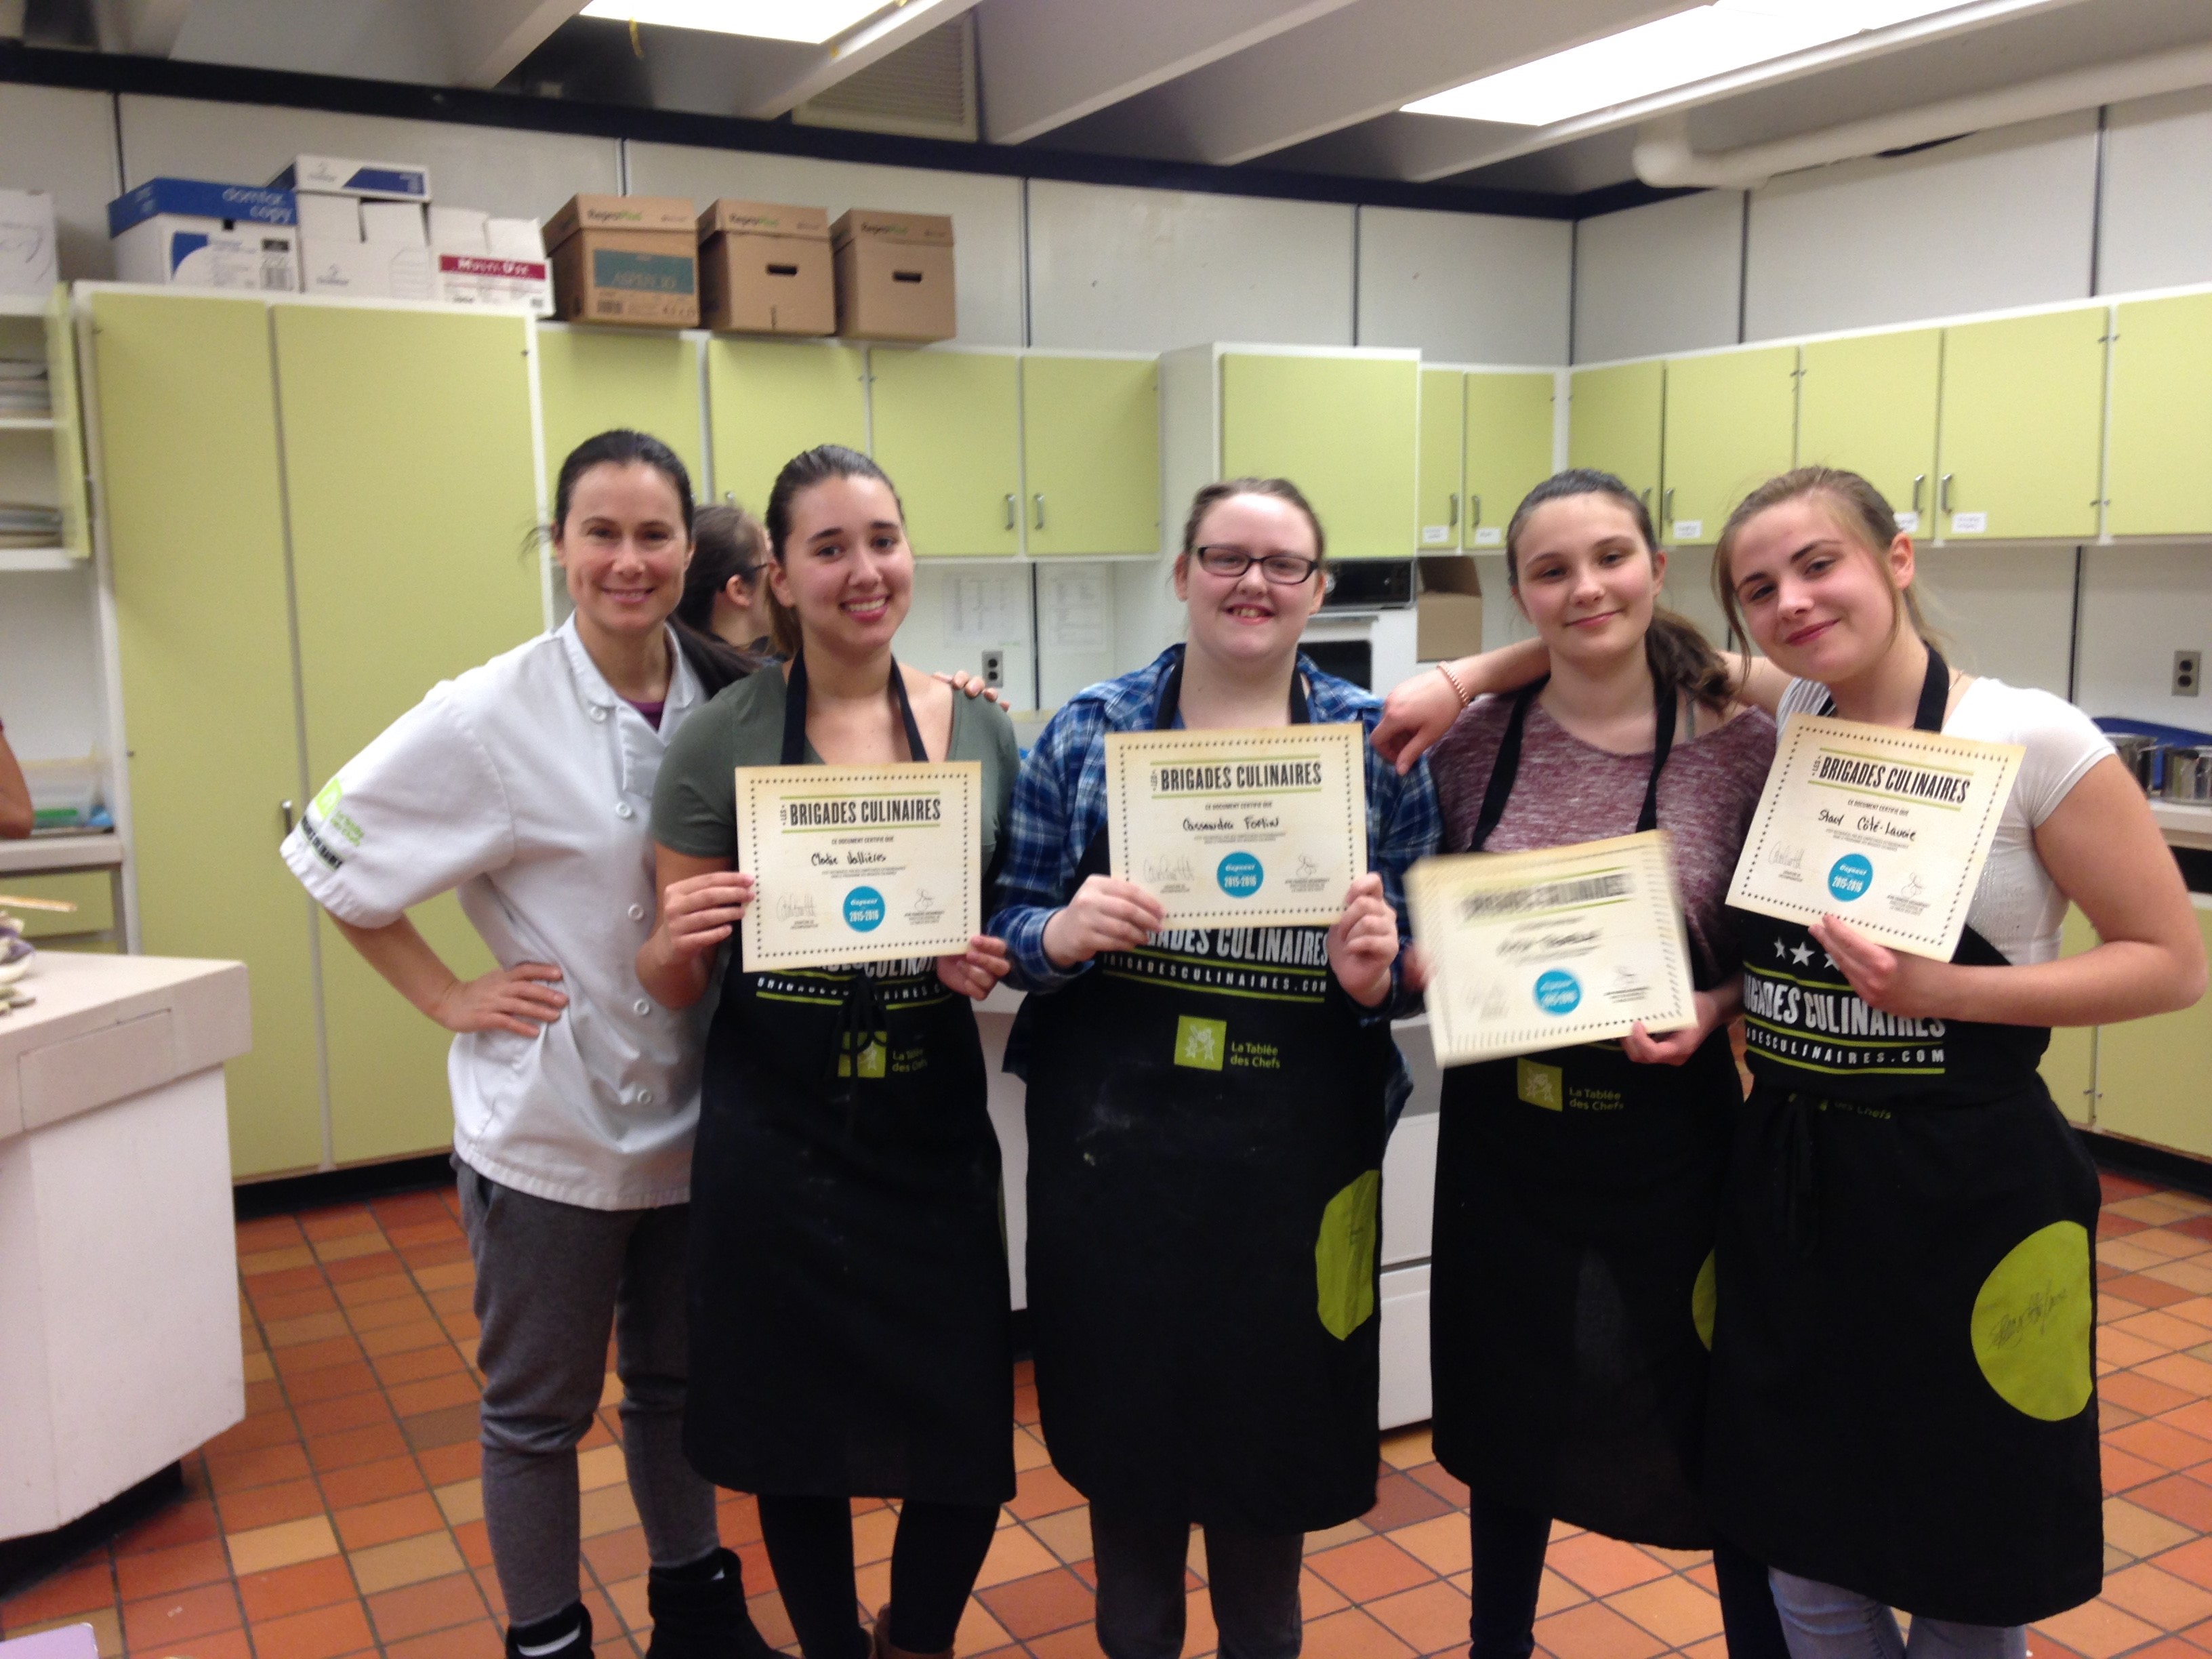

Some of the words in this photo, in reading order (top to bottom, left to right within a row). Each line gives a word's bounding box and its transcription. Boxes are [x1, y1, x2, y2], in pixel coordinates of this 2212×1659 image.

[1161, 766, 1232, 792] BRIGADES
[1236, 762, 1322, 788] CULINAIRES
[1819, 756, 1886, 788] BRIGADES
[1884, 766, 1971, 804] CULINAIRES
[790, 802, 857, 826] BRIGADES
[861, 798, 941, 823] CULINAIRES
[1224, 874, 1257, 888] 2015-2016
[1832, 875, 1864, 893] 2015-2016
[848, 909, 880, 922] 2015-2016
[1231, 1042, 1244, 1053] La
[1246, 1042, 1279, 1056] Tablée
[892, 1062, 910, 1073] des
[1230, 1053, 1249, 1067] des
[1252, 1055, 1281, 1069] Chefs
[1569, 1086, 1582, 1098] La
[1569, 1098, 1589, 1110] des
[1593, 1101, 1624, 1111] Chefs
